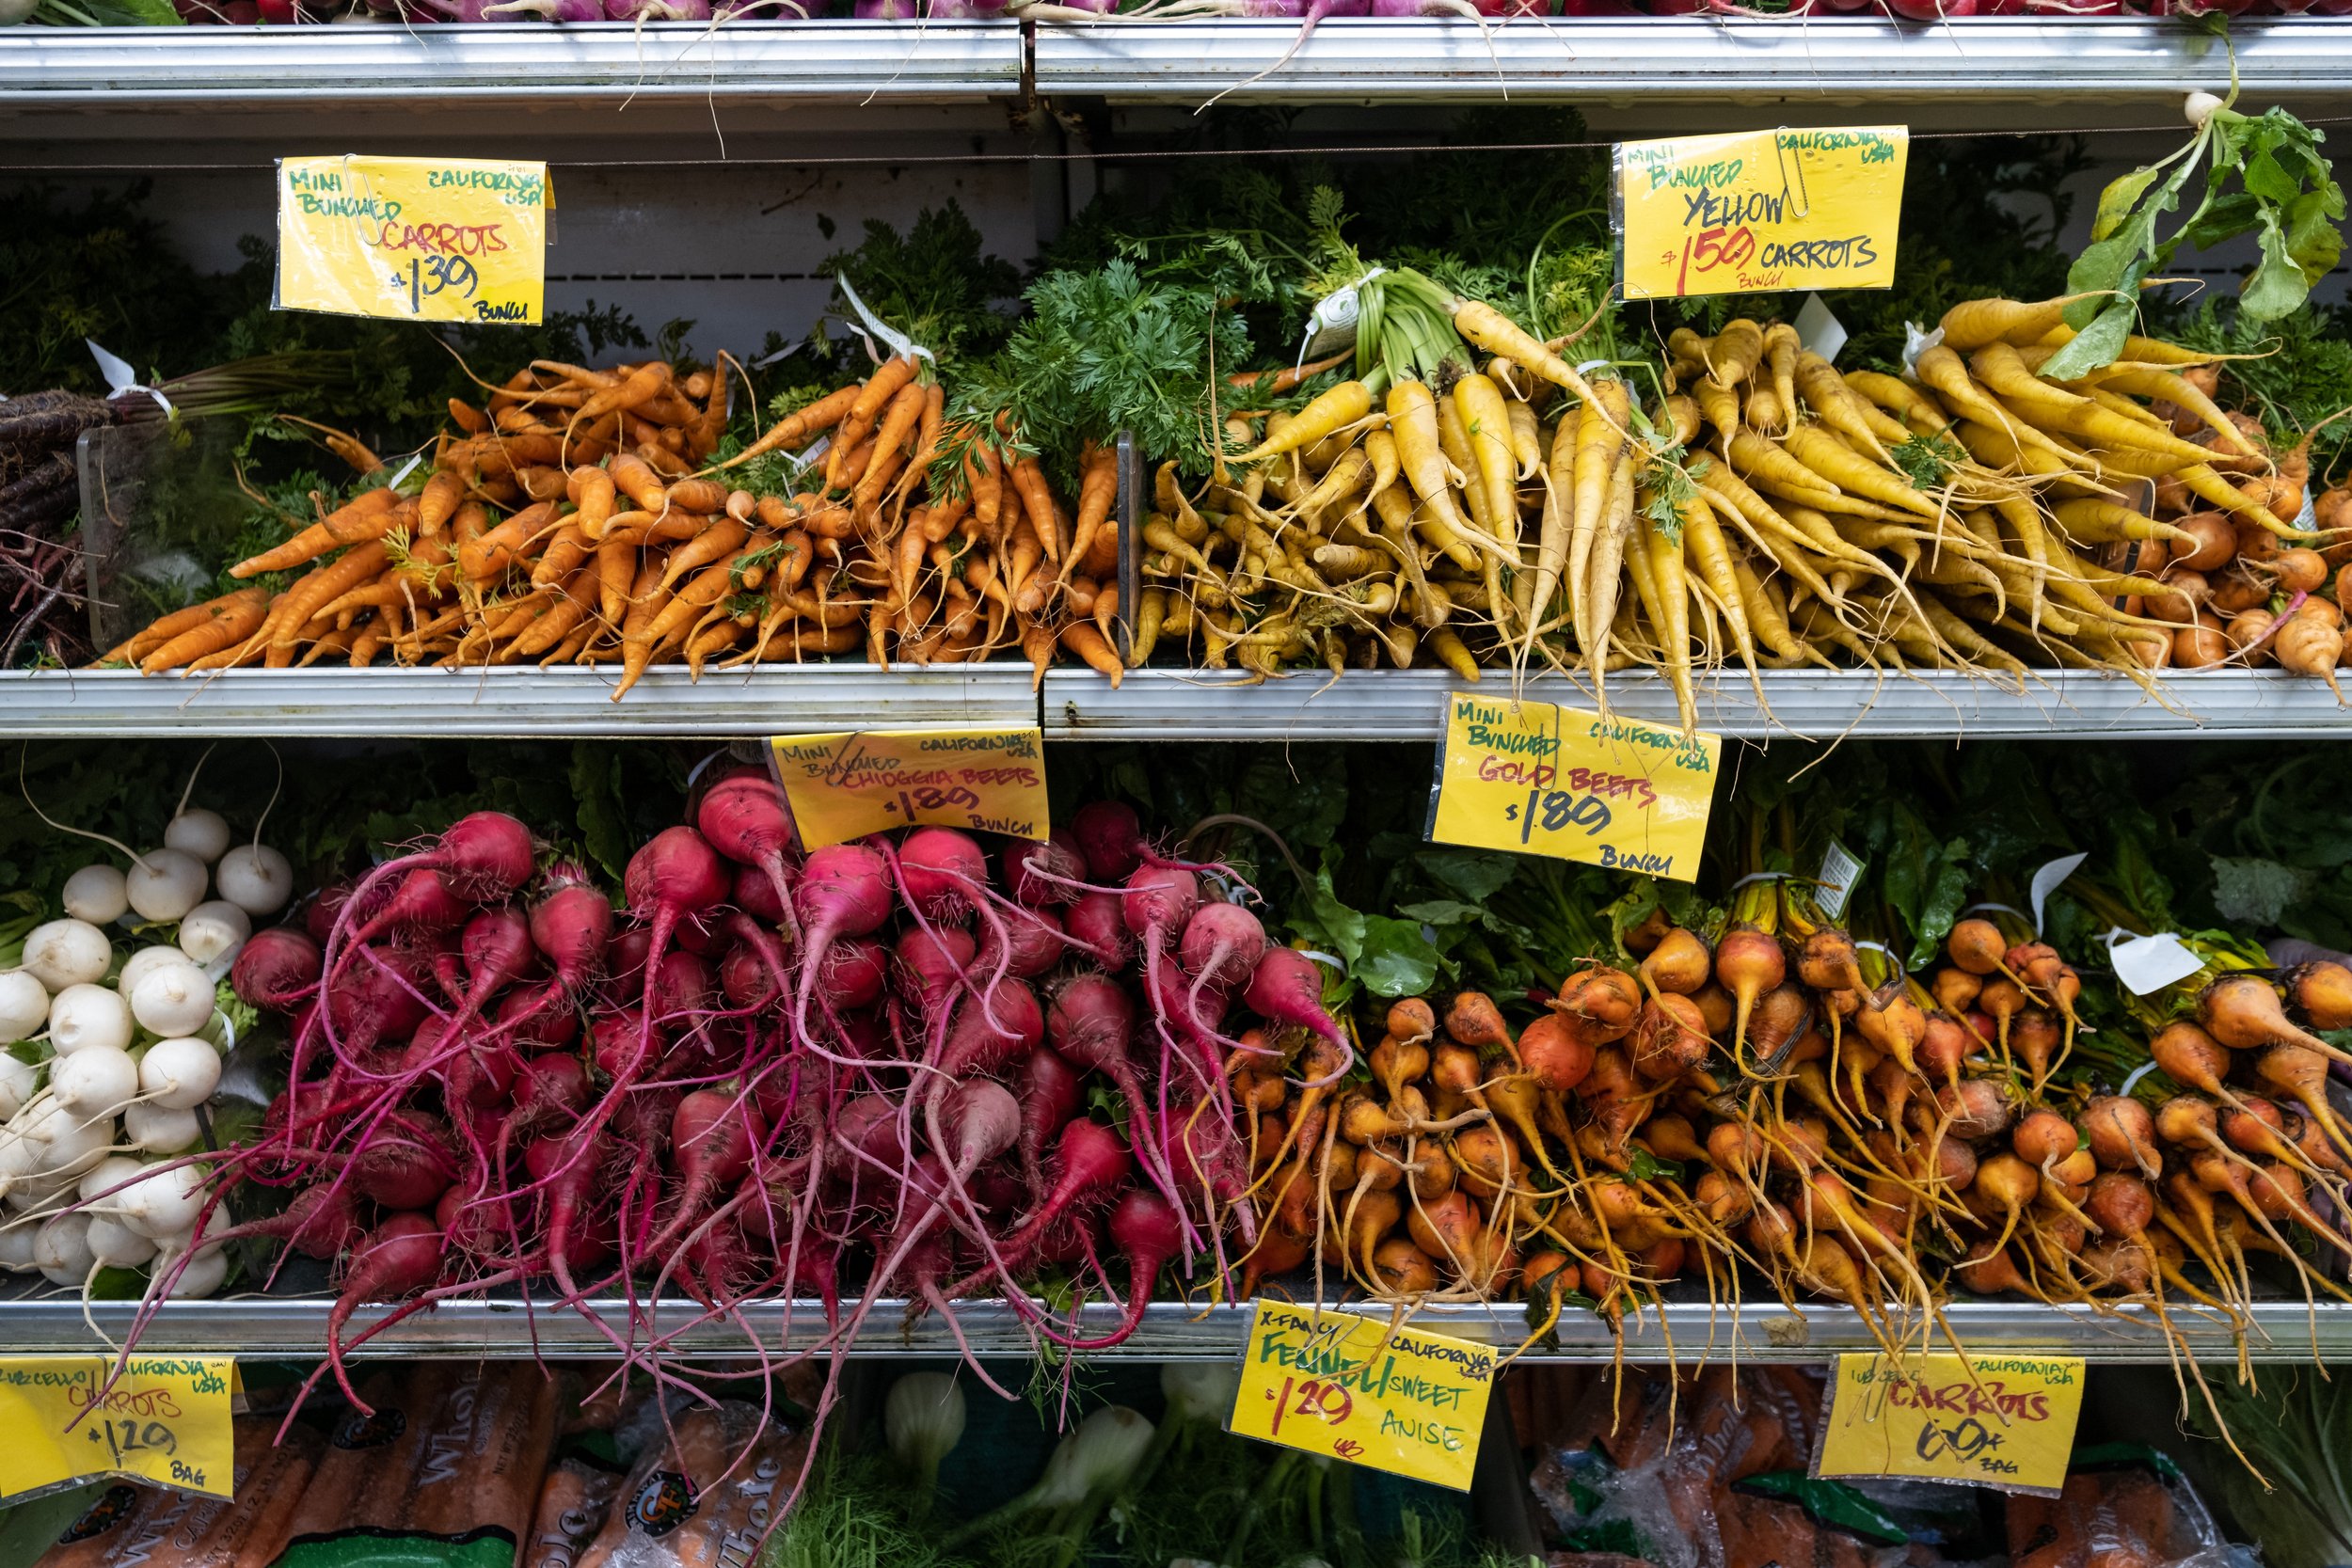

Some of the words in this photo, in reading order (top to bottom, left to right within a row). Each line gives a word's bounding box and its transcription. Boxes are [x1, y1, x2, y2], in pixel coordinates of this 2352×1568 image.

[1628, 144, 1674, 164] MINI
[289, 168, 342, 192] MINI
[505, 188, 544, 206] USA
[1683, 185, 1788, 229] YELLOW
[381, 221, 508, 258] CARROTS
[1760, 234, 1878, 270] CARROTS
[1736, 270, 1784, 289] BUNCH
[472, 299, 528, 321] BUNCH
[1457, 702, 1502, 724] MINI
[1467, 724, 1561, 757] BUNCHED
[781, 746, 833, 765] MINI
[957, 767, 1040, 788] BEETS
[1478, 754, 1554, 787] GOLD
[1568, 768, 1657, 810] BEETS
[968, 814, 1033, 836] BUNCH
[1598, 844, 1674, 876] BUNCH
[192, 1371, 226, 1394] USA
[2045, 1374, 2074, 1386] USA
[1380, 1409, 1465, 1452] ANISE
[170, 1460, 206, 1487] BAG
[1979, 1458, 2019, 1474] BAG
